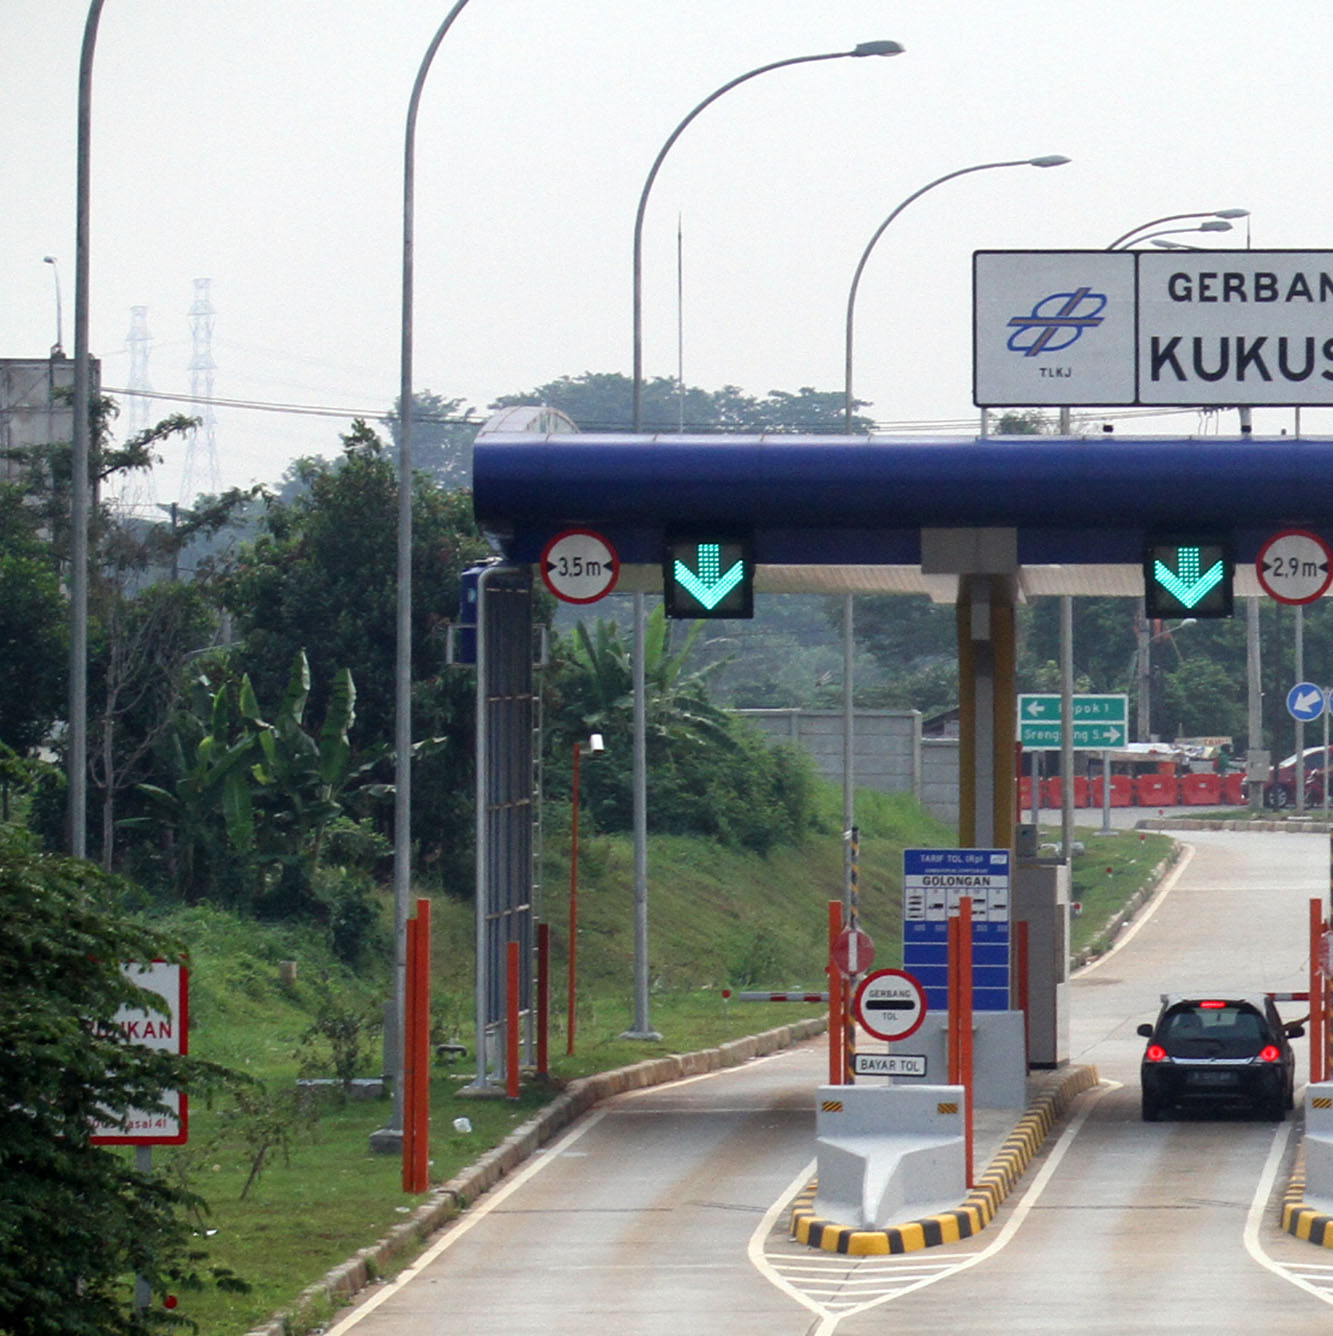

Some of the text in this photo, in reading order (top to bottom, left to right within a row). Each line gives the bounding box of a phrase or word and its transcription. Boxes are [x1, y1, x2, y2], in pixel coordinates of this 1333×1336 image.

[1039, 367, 1072, 378] TLKJ
[586, 560, 601, 576] m
[1302, 561, 1318, 577] m
[922, 875, 991, 886] GOLONGAN
[869, 989, 912, 998] GERBANG
[882, 1012, 899, 1021] TOL
[860, 1058, 920, 1072] BAYAR TOL
